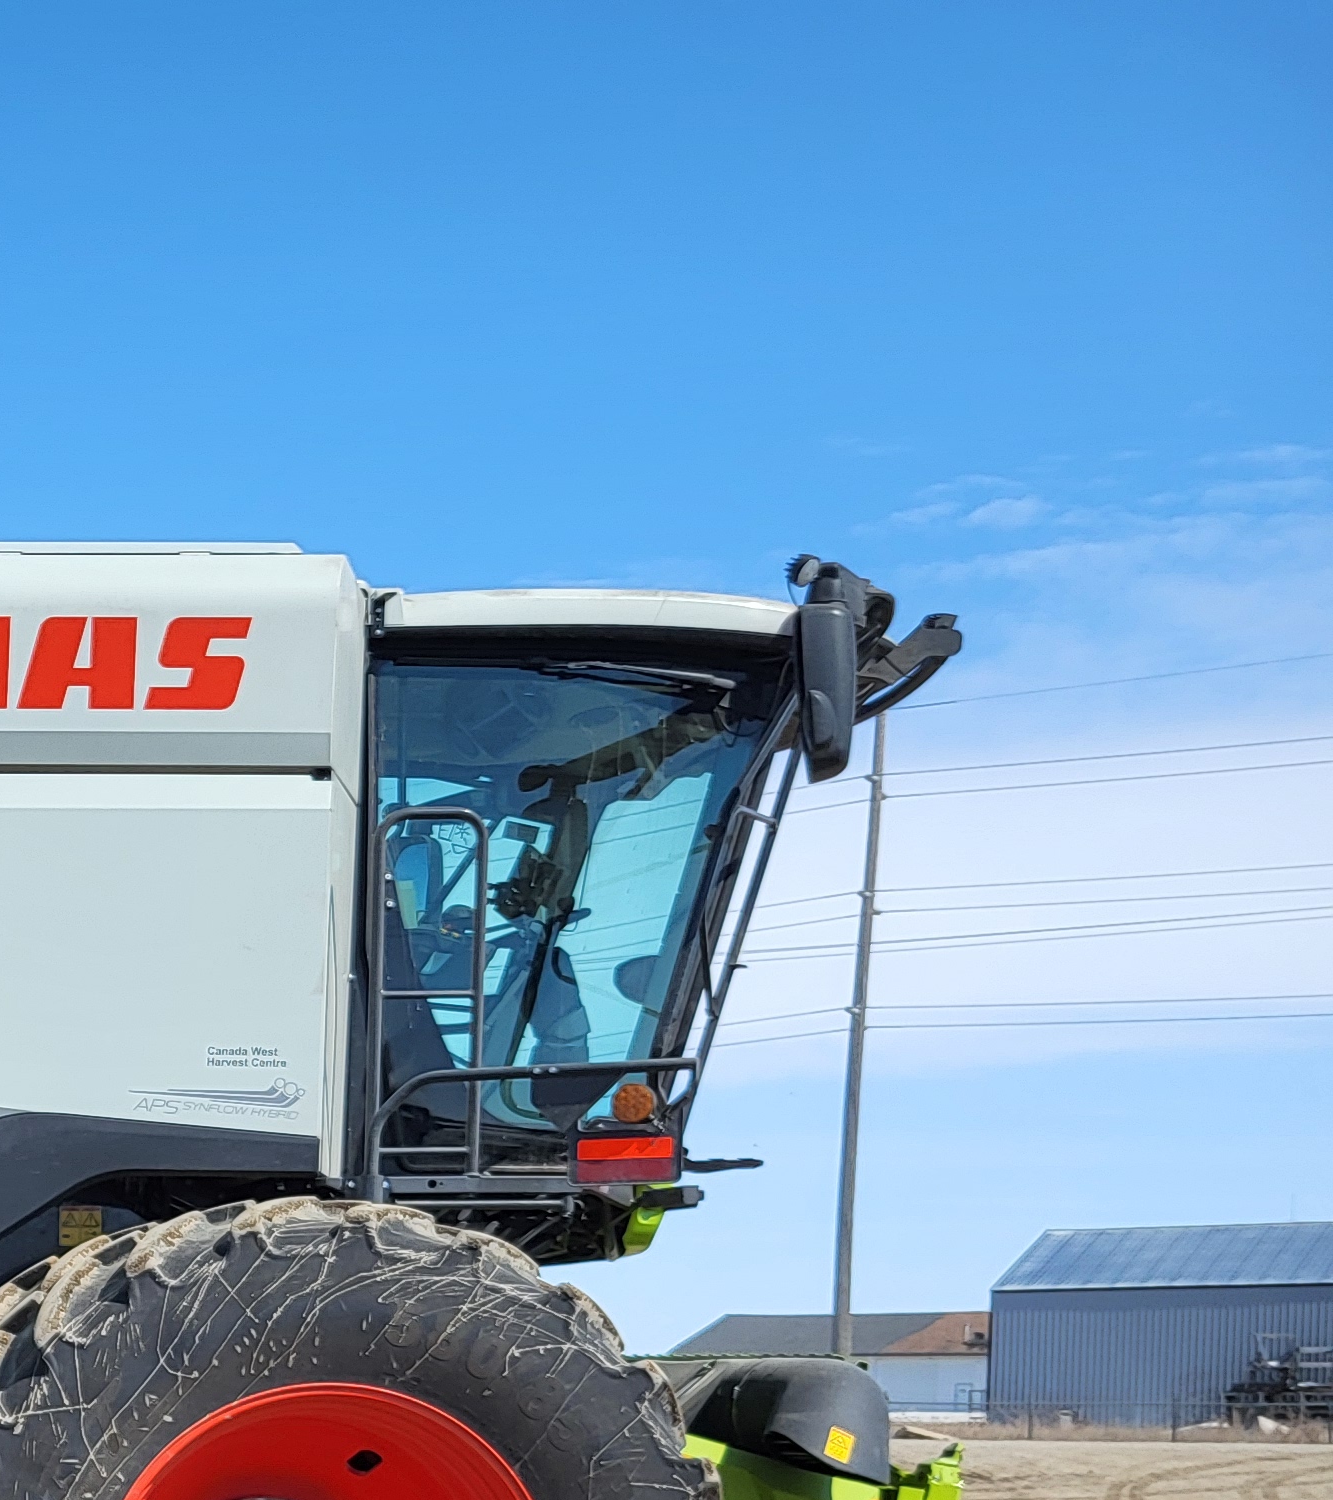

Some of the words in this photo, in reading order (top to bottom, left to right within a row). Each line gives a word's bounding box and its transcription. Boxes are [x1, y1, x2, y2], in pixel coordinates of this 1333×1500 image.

[206, 1046, 248, 1057] Canada
[251, 1046, 279, 1057] West
[206, 1057, 249, 1068] Harvest
[251, 1058, 287, 1068] Centre
[133, 1097, 181, 1115] APS
[182, 1101, 250, 1116] SYNFLOW
[250, 1108, 300, 1121] HYBRID
